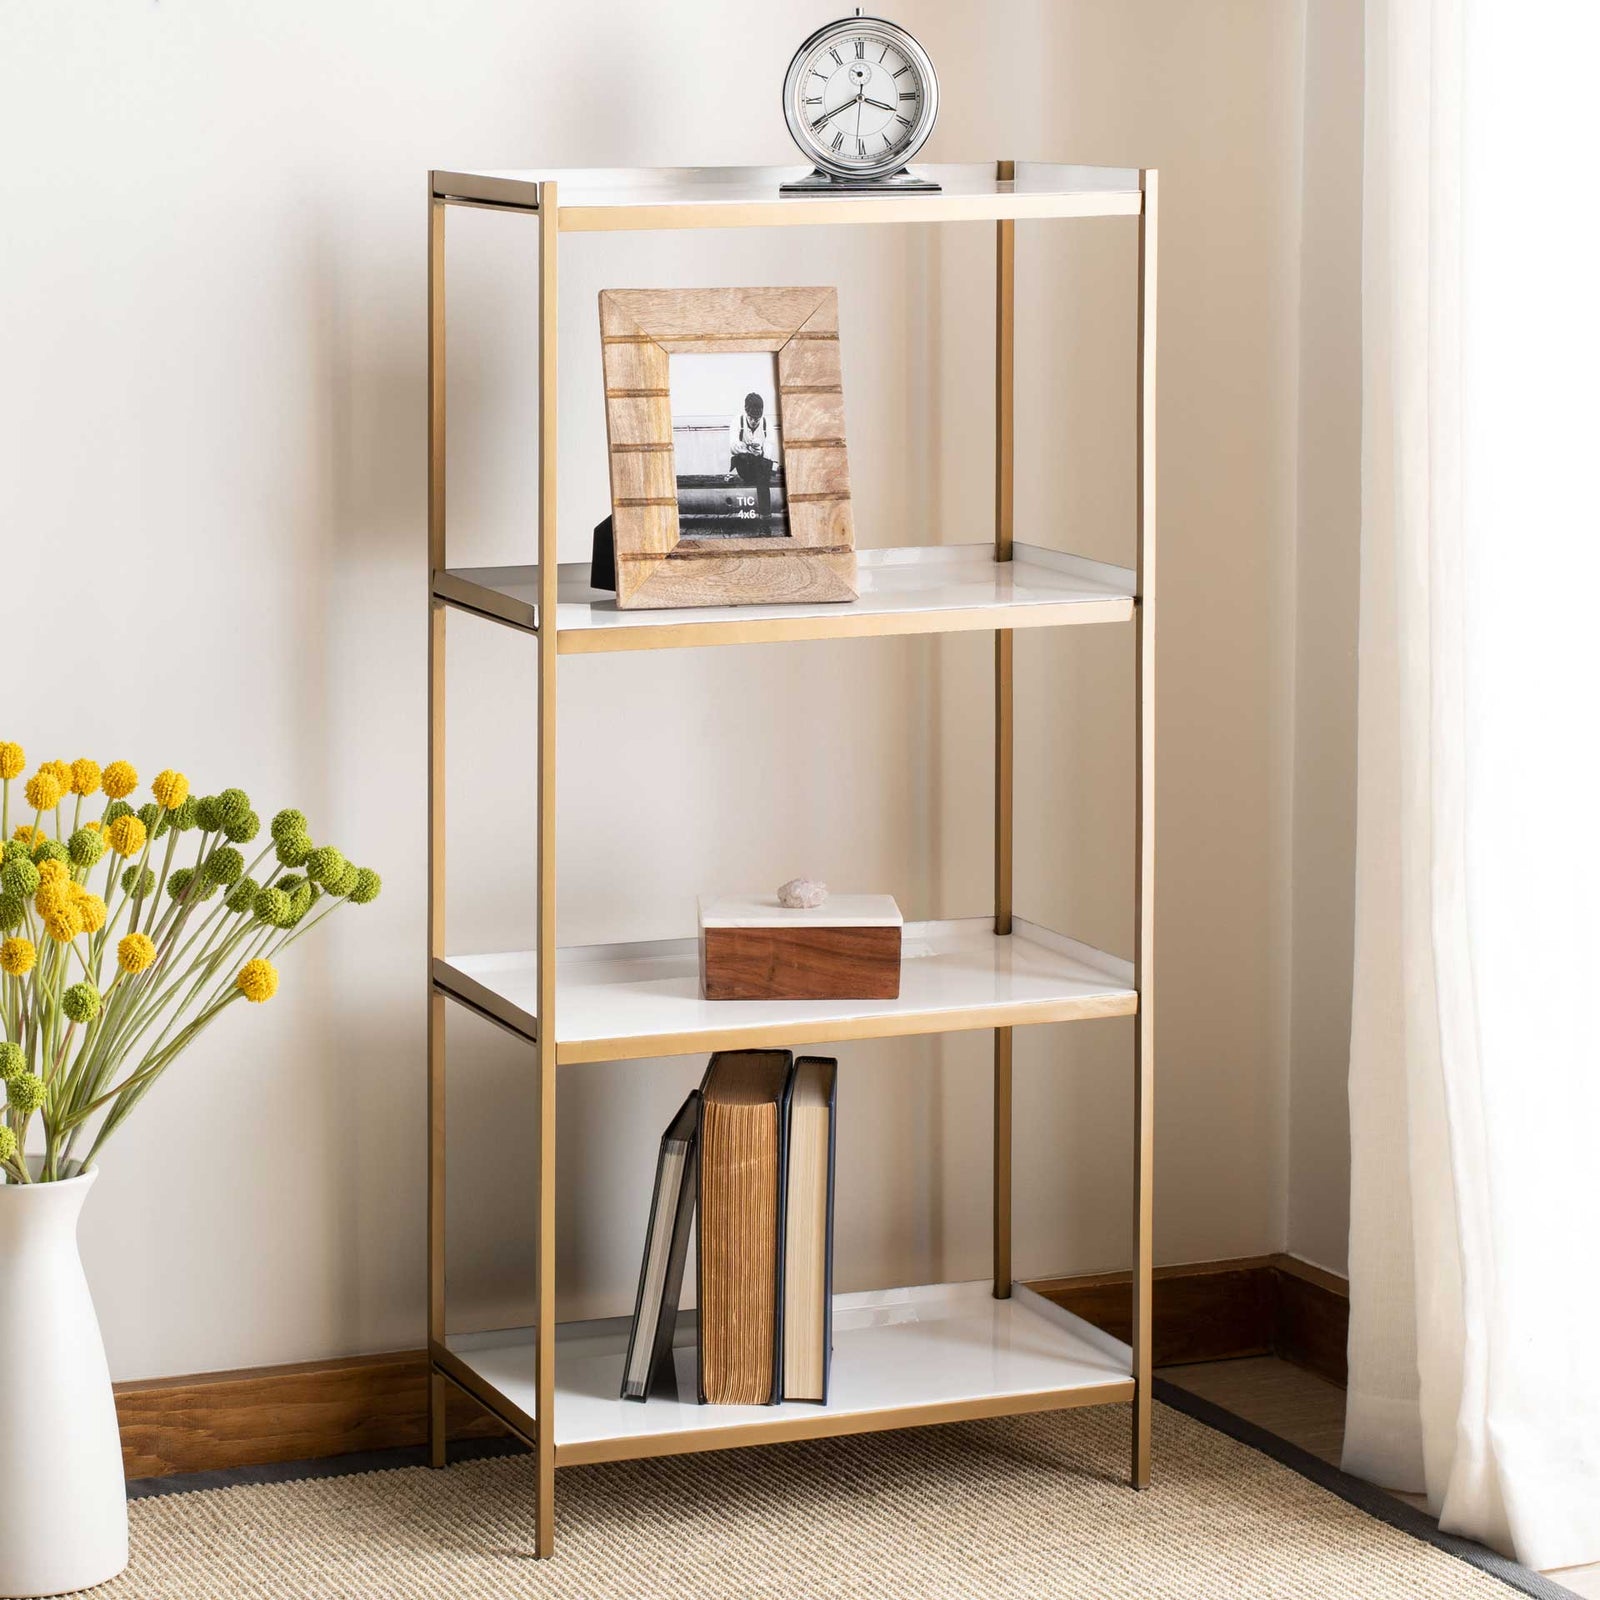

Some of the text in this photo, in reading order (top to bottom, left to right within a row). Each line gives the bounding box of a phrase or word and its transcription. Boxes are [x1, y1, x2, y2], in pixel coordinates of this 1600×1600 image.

[854, 42, 865, 60] XII
[829, 49, 844, 67] XI
[811, 69, 828, 82] X
[892, 66, 909, 79] II
[805, 96, 823, 105] IX
[899, 92, 916, 101] III
[830, 131, 845, 151] VII
[736, 496, 755, 506] TIC
[738, 509, 757, 519] 4x6
